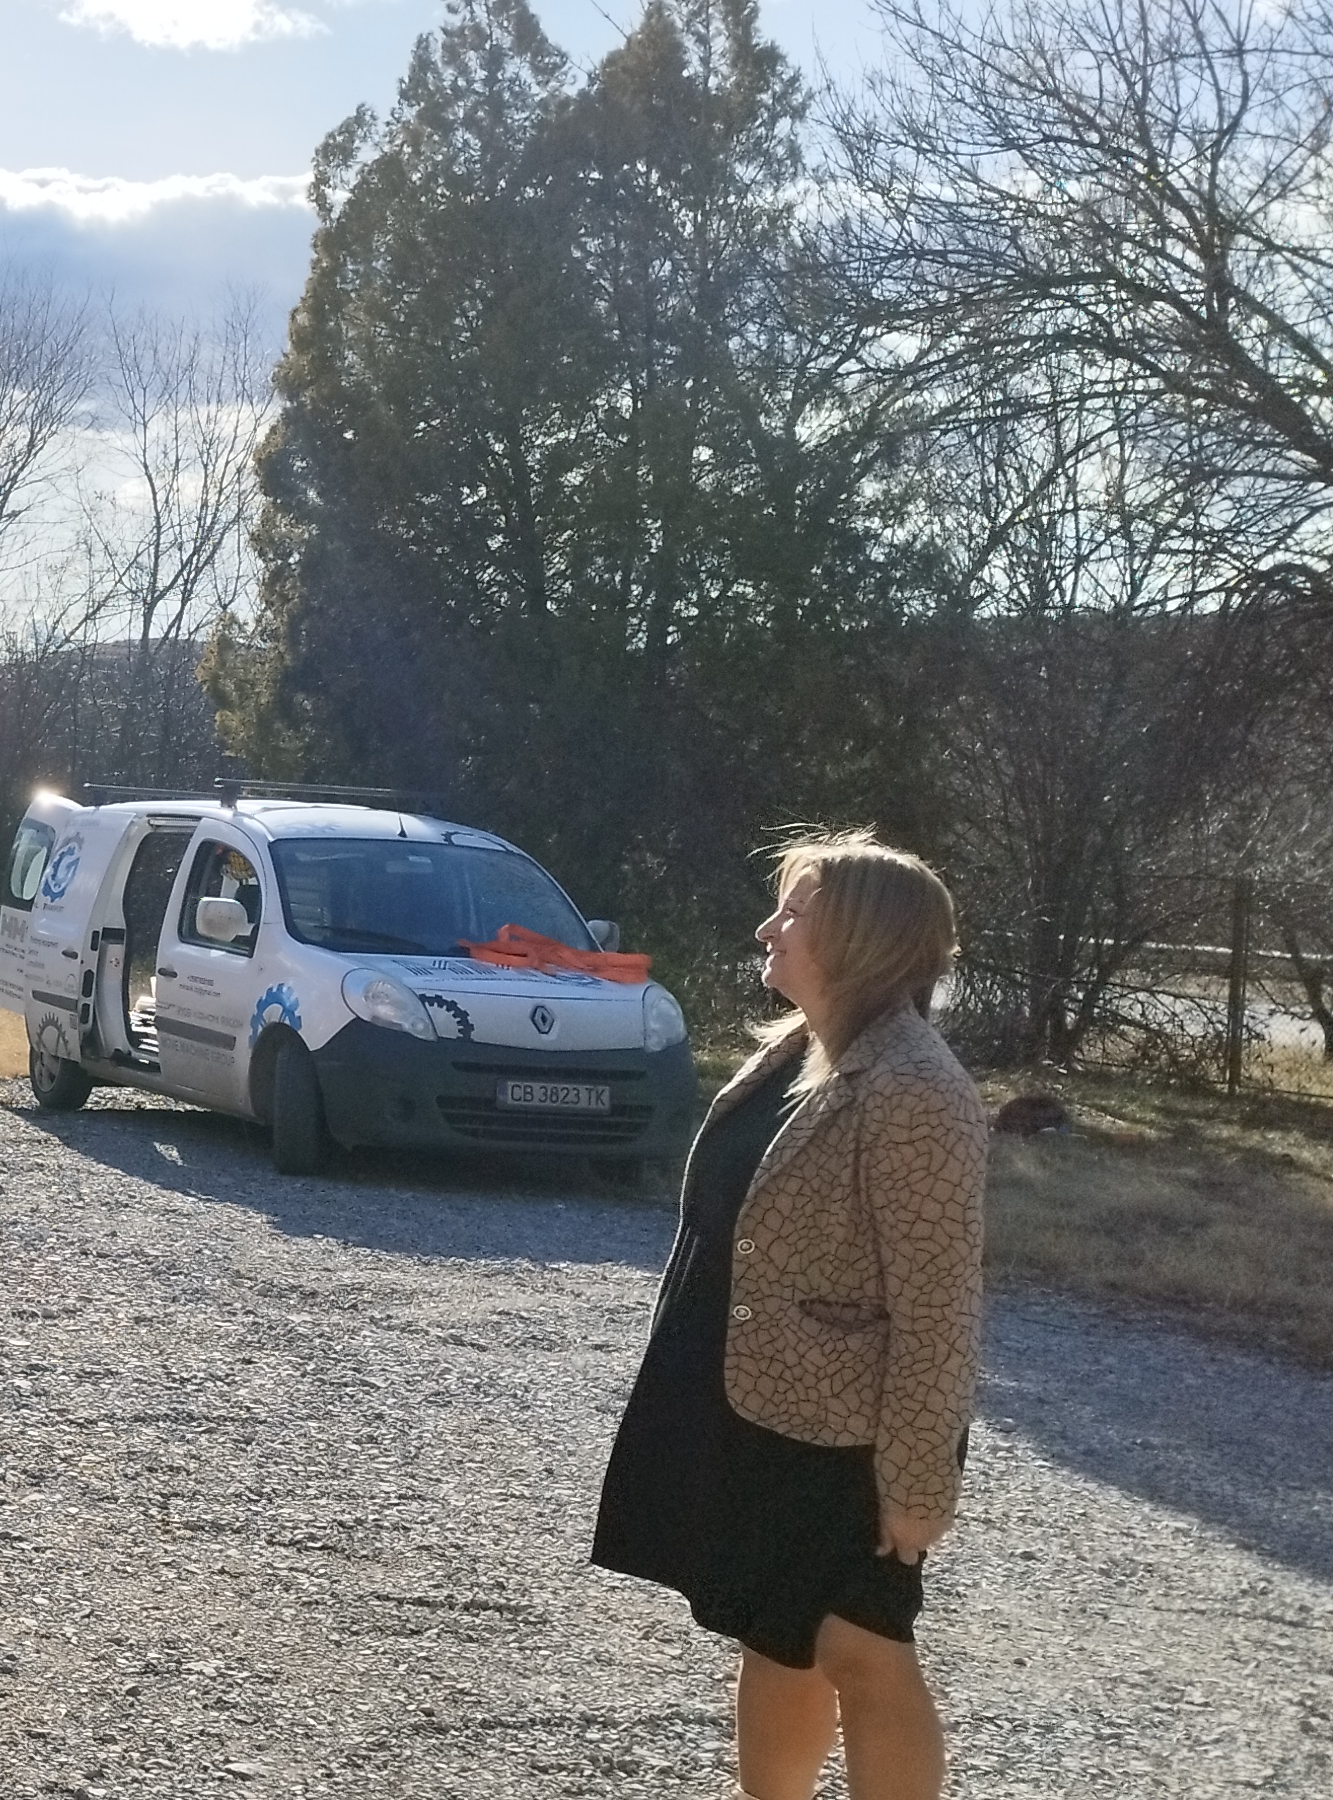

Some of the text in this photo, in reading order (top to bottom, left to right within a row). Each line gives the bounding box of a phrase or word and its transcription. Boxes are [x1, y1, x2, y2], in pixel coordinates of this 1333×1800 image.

[510, 1084, 606, 1107] CB 3823 TK
